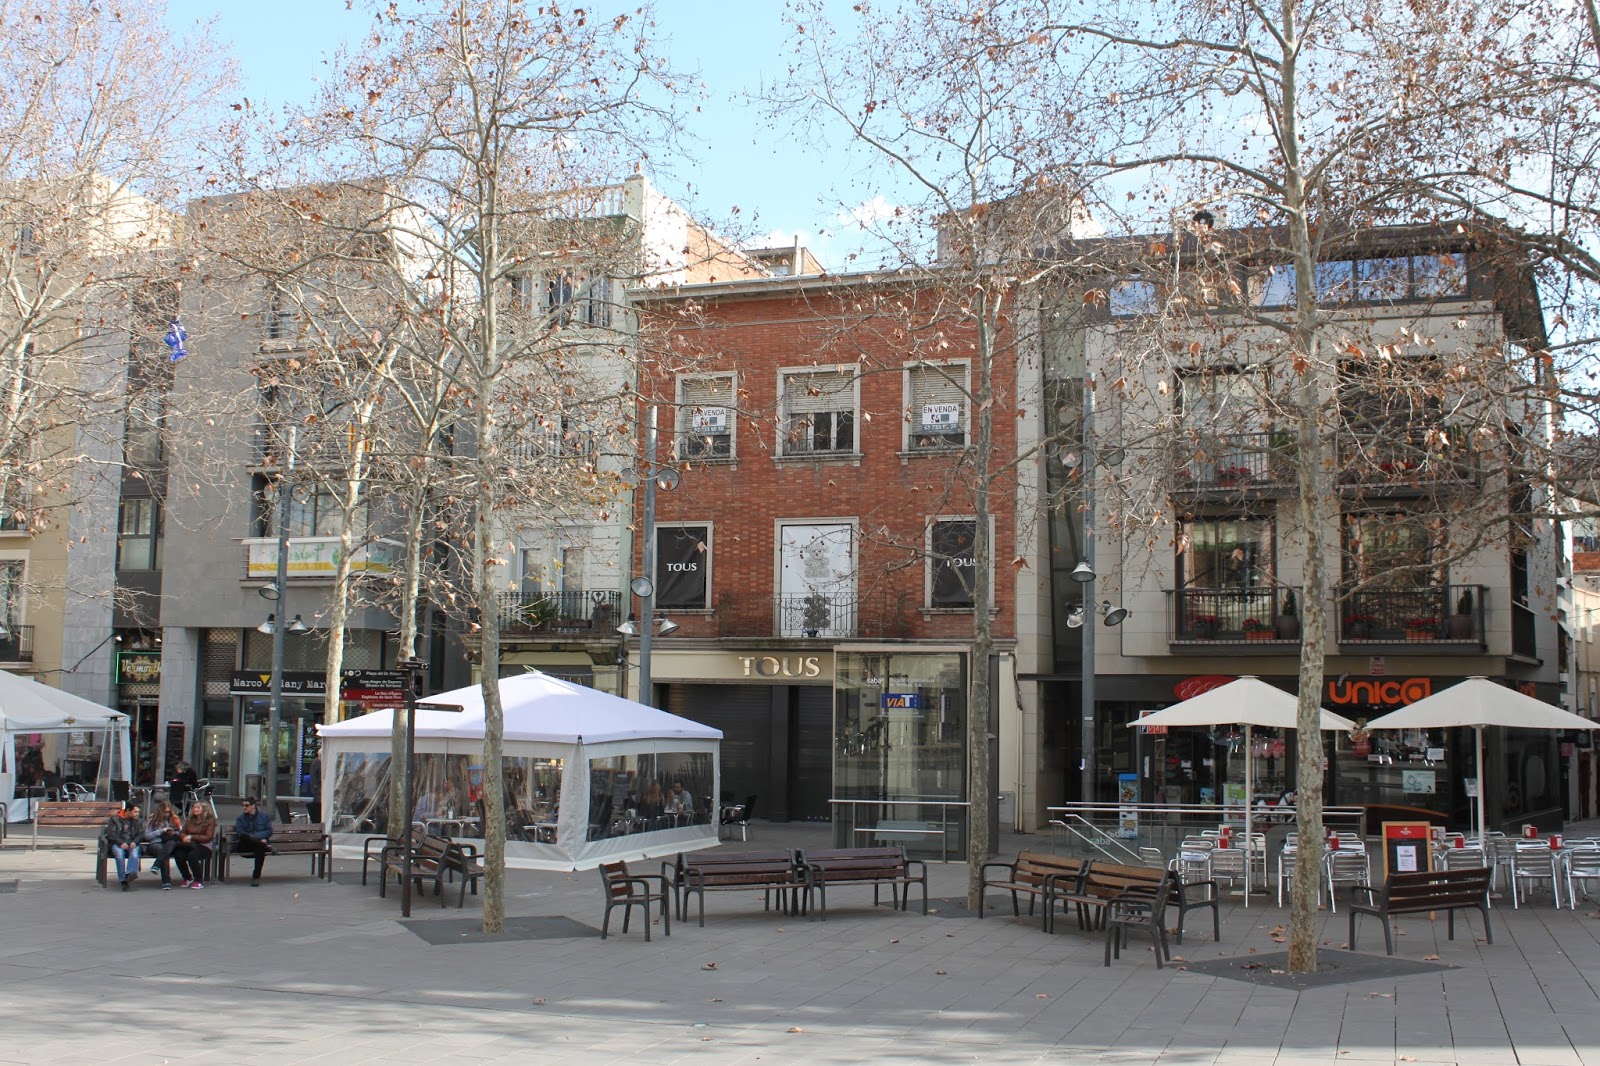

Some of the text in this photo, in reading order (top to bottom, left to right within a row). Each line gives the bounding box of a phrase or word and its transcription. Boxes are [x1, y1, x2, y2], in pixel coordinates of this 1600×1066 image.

[934, 405, 957, 413] VENDA
[666, 562, 698, 572] TOUS
[738, 656, 820, 677] TOUS
[233, 679, 263, 687] Marco
[267, 680, 303, 690] Aany
[866, 676, 882, 684] saba
